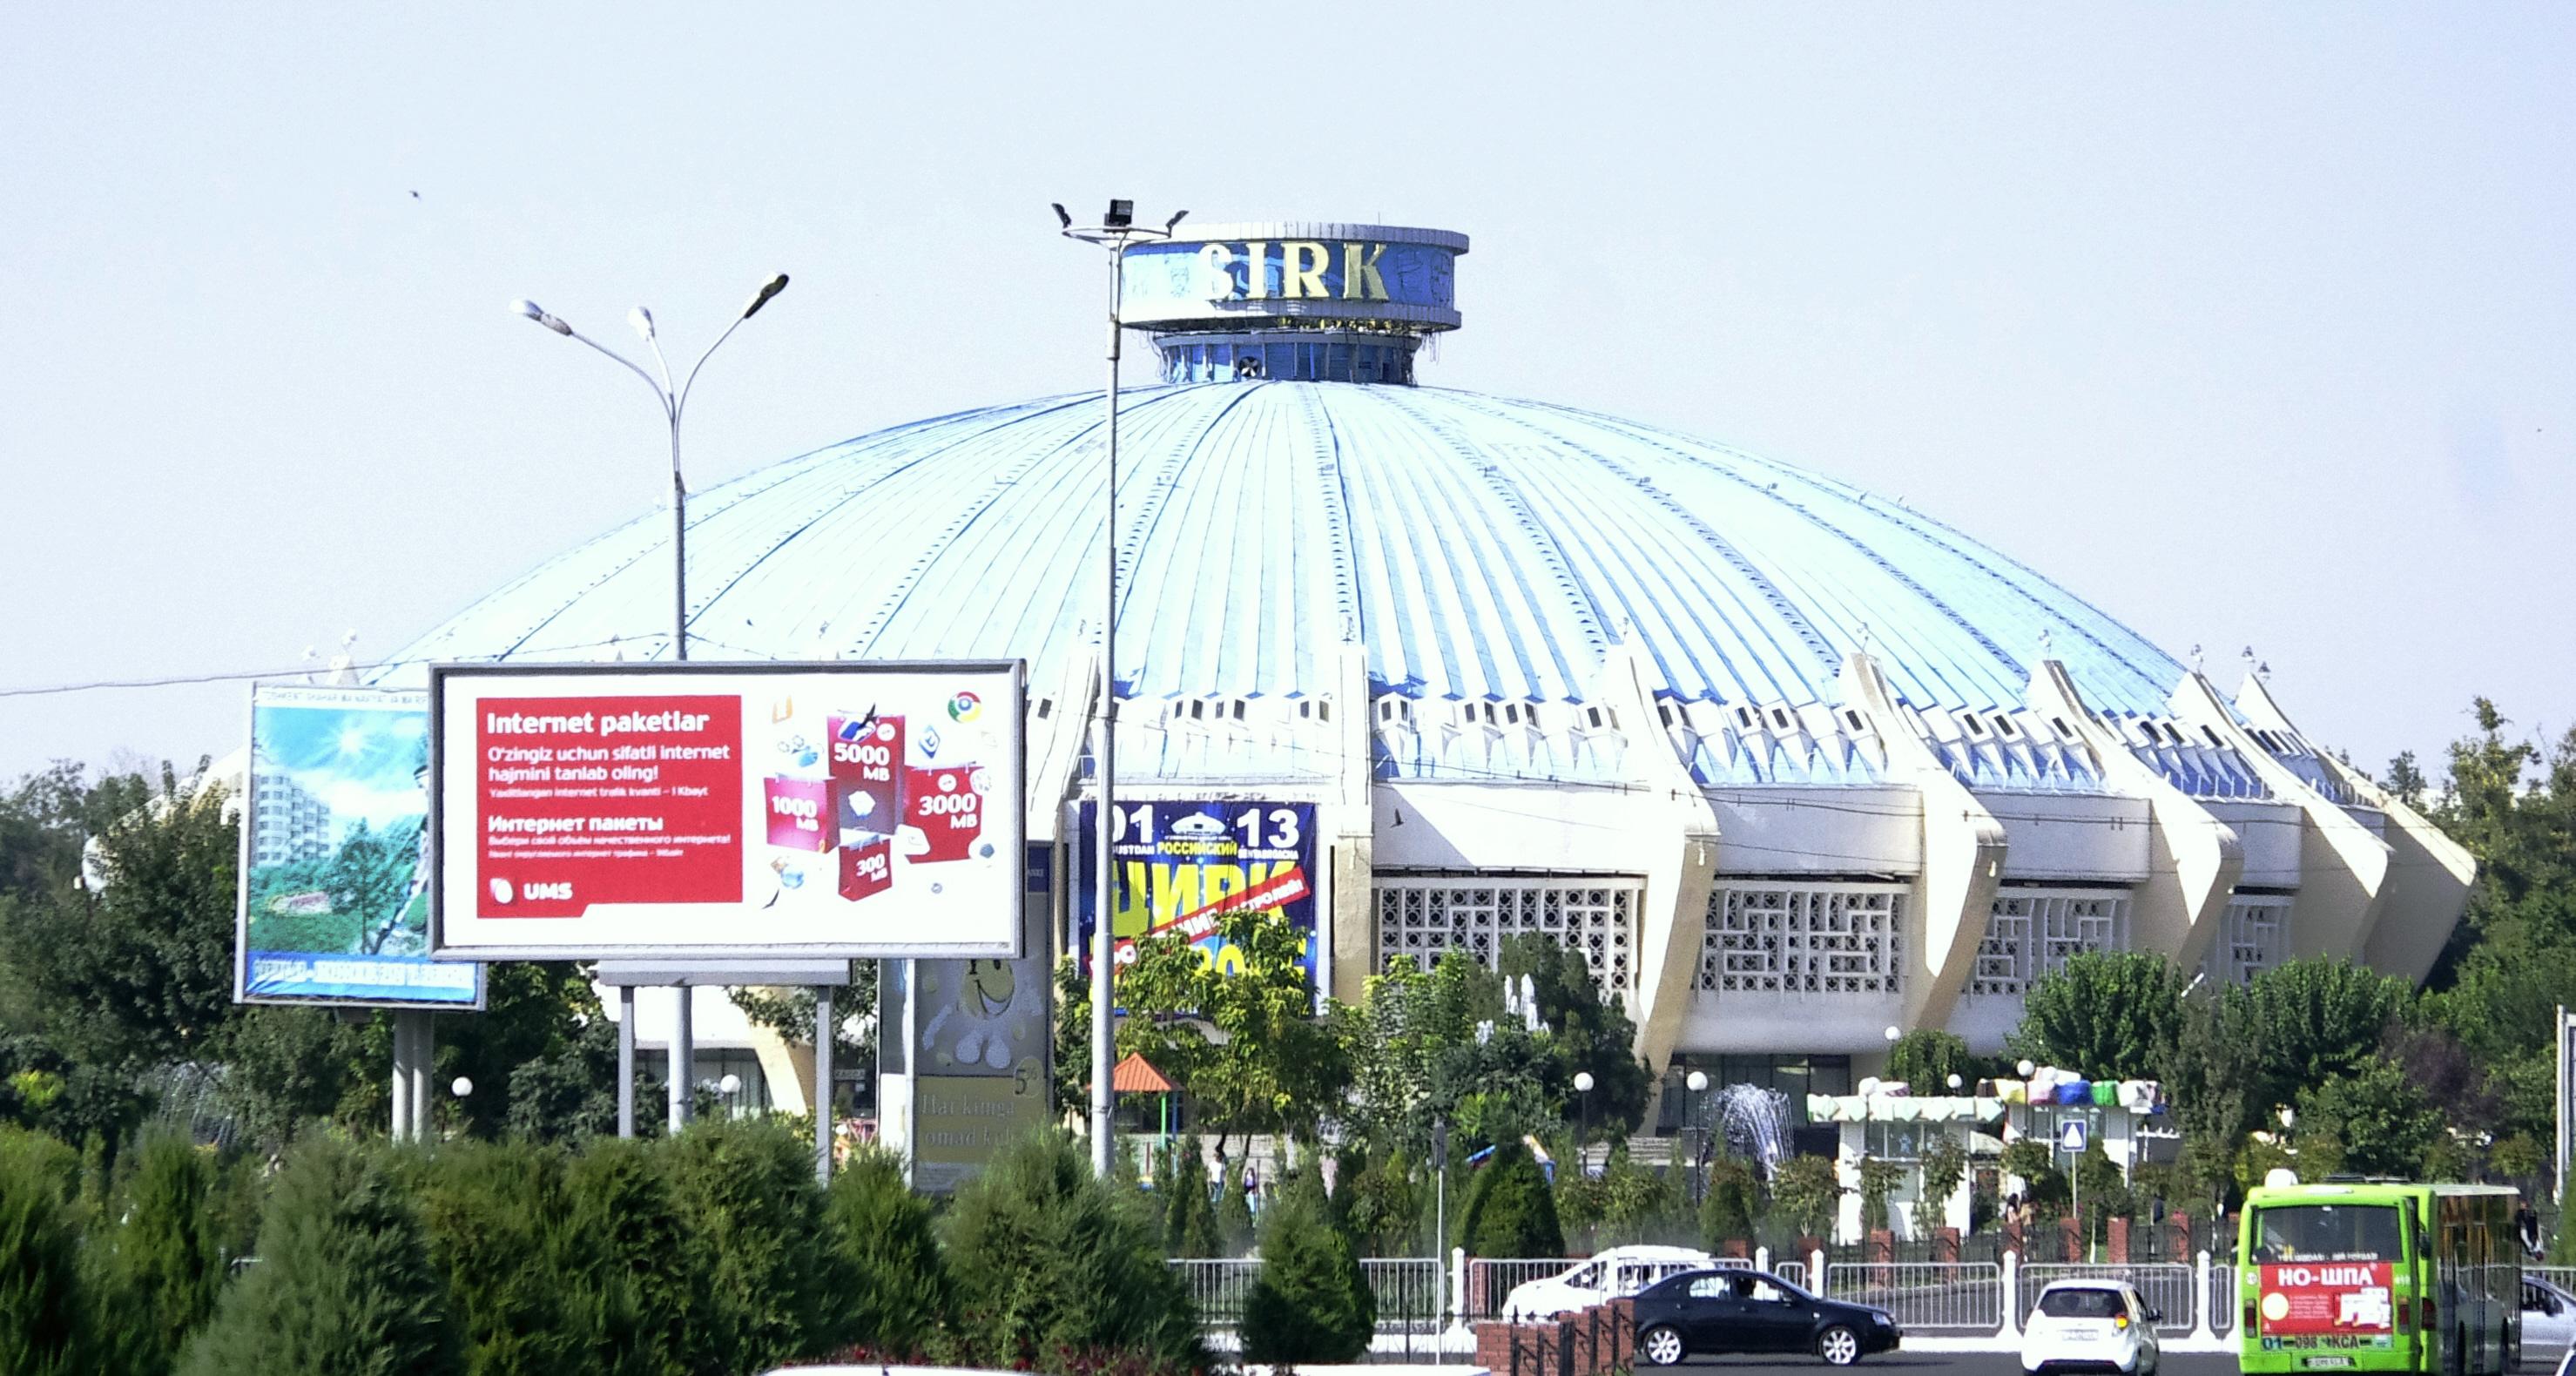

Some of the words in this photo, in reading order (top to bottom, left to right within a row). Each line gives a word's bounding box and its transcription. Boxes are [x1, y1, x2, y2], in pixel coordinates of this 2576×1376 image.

[1198, 242, 1389, 300] SIRK
[487, 712, 595, 733] Internet
[600, 711, 710, 737] paketlar
[488, 745, 553, 765] O'zingiz
[556, 745, 609, 761] uchun
[611, 745, 657, 760] sifatli
[659, 744, 731, 760] internet
[834, 742, 890, 766] 5000
[488, 766, 550, 784] hajmini
[554, 766, 608, 781] tanlab
[611, 766, 658, 783] oling!
[863, 766, 890, 781] MB
[554, 787, 598, 798] internet
[772, 795, 818, 819] 1000
[918, 793, 976, 816] 3000
[488, 815, 585, 835] Интернет
[589, 816, 664, 832] пакеты
[796, 817, 819, 832] MB
[950, 813, 978, 829] MB
[1237, 808, 1299, 848] 13
[1157, 840, 1237, 856] РОССИЙСКИЙ
[856, 853, 886, 877] 300
[523, 882, 573, 900] UMS
[1112, 860, 1297, 939] ЦИРК
[2277, 1267, 2374, 1287] НО-ШПА
